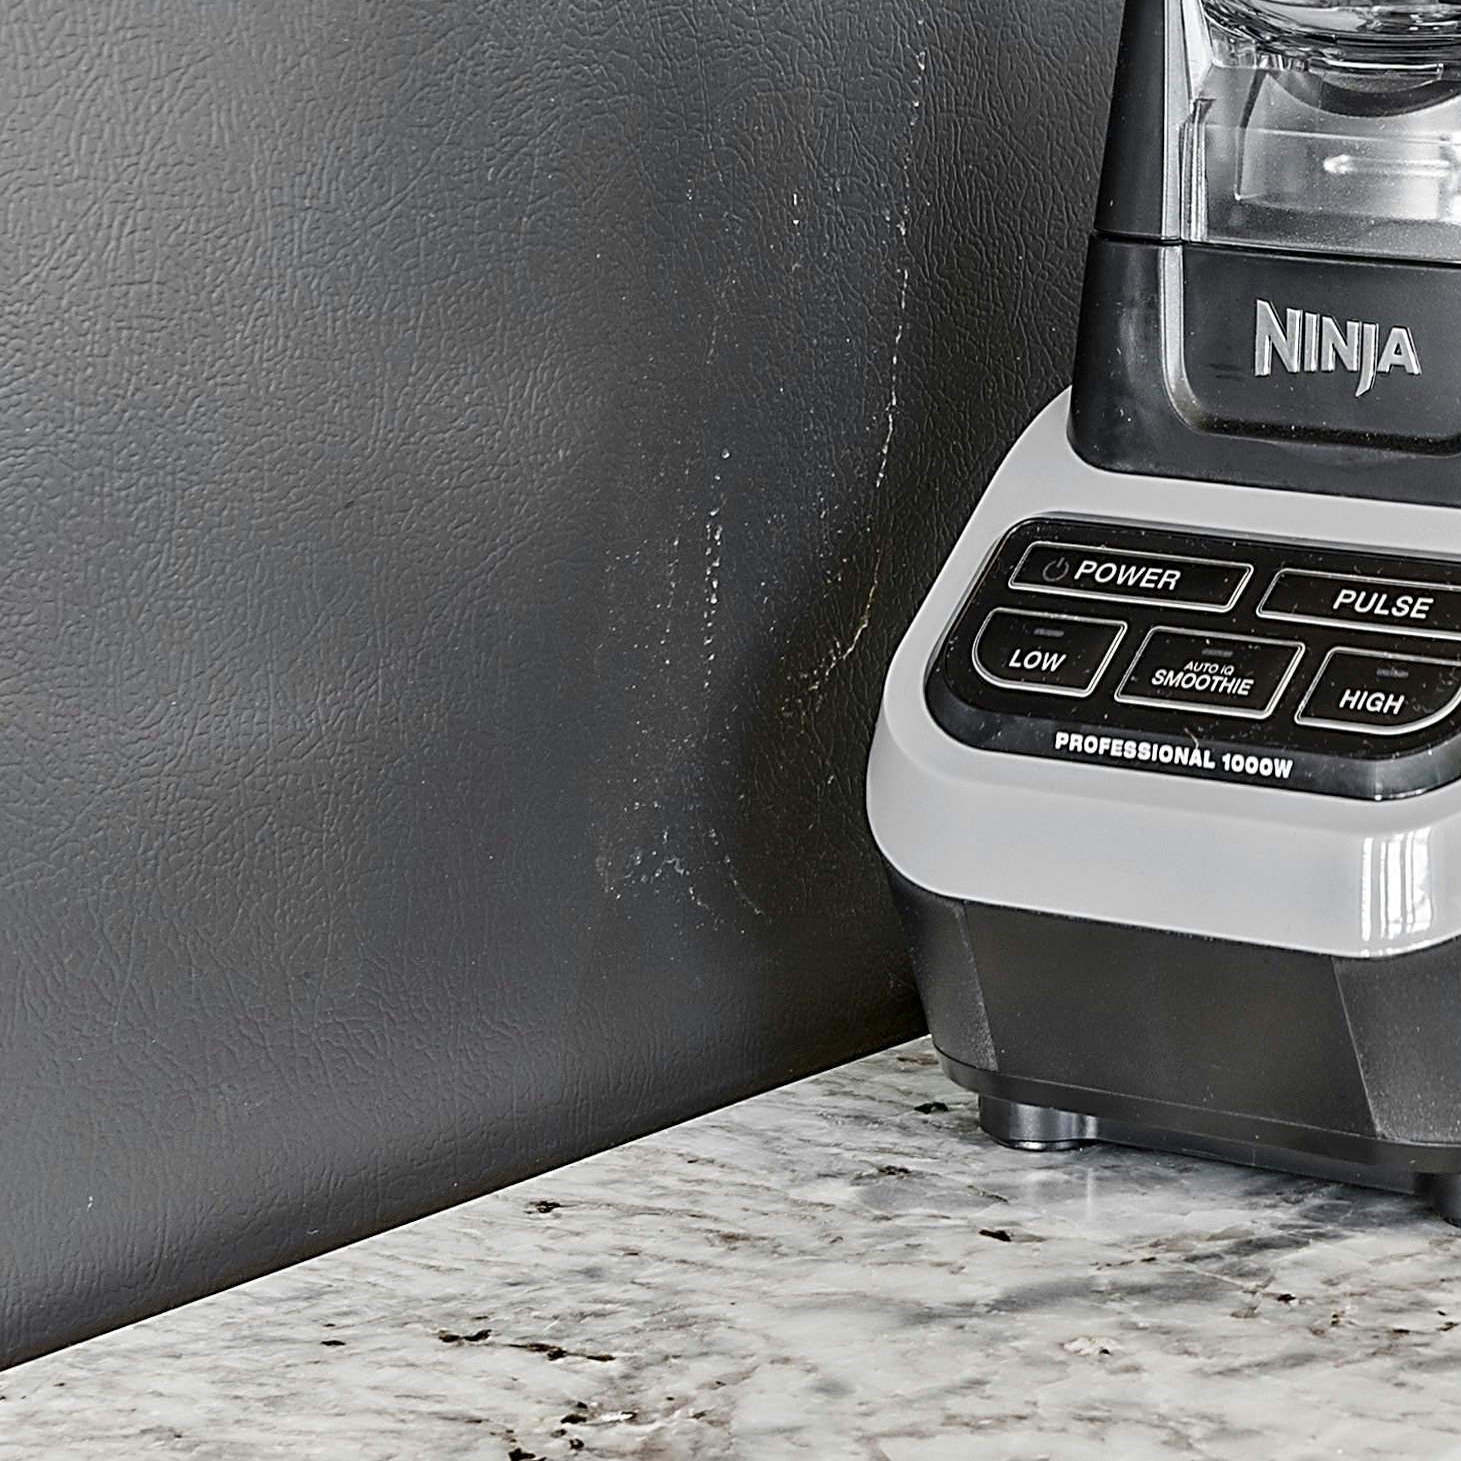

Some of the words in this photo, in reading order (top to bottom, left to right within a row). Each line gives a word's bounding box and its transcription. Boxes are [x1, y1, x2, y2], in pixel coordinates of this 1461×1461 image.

[1254, 298, 1422, 398] NINJA
[1074, 558, 1182, 591] POWER
[1332, 588, 1435, 620] PULSE
[1008, 647, 1067, 673] LOW
[1183, 660, 1219, 674] AUTO
[1151, 669, 1255, 697] SMOOTHIE
[1338, 688, 1406, 716] HIGH
[1055, 731, 1216, 770] PROFESSIONAL
[1222, 752, 1294, 779] 1000W
